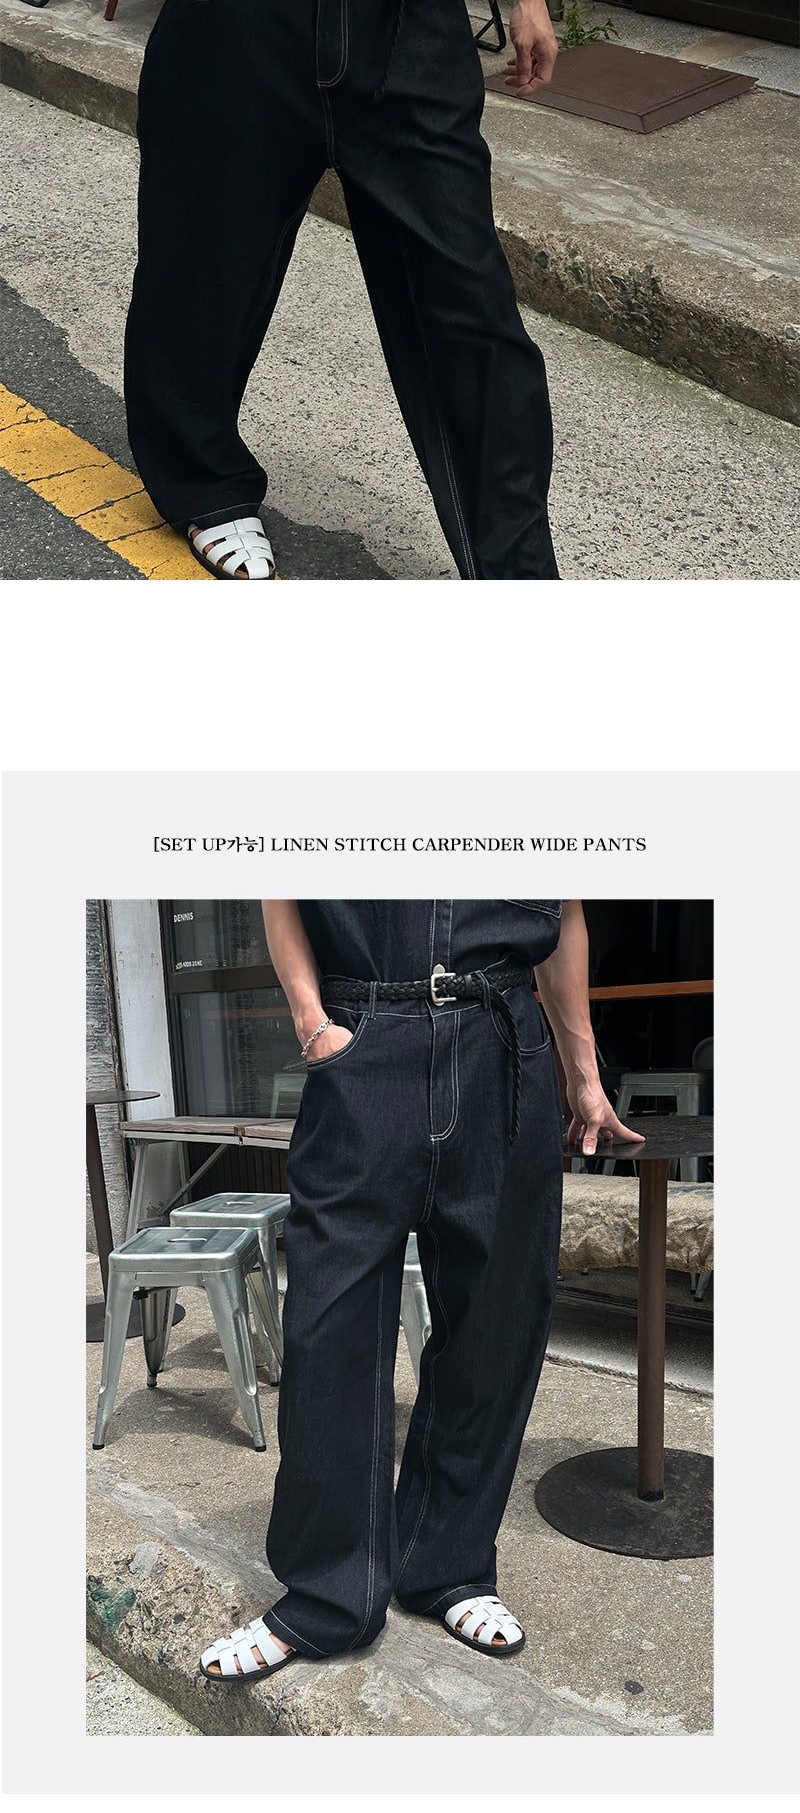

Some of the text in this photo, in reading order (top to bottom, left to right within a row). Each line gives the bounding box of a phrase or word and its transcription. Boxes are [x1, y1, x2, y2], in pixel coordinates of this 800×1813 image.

[154, 837, 646, 852] [SET UP가능] LINEN STITCH CARPENDER WIDE PANTS
[173, 912, 194, 923] DENNIS
